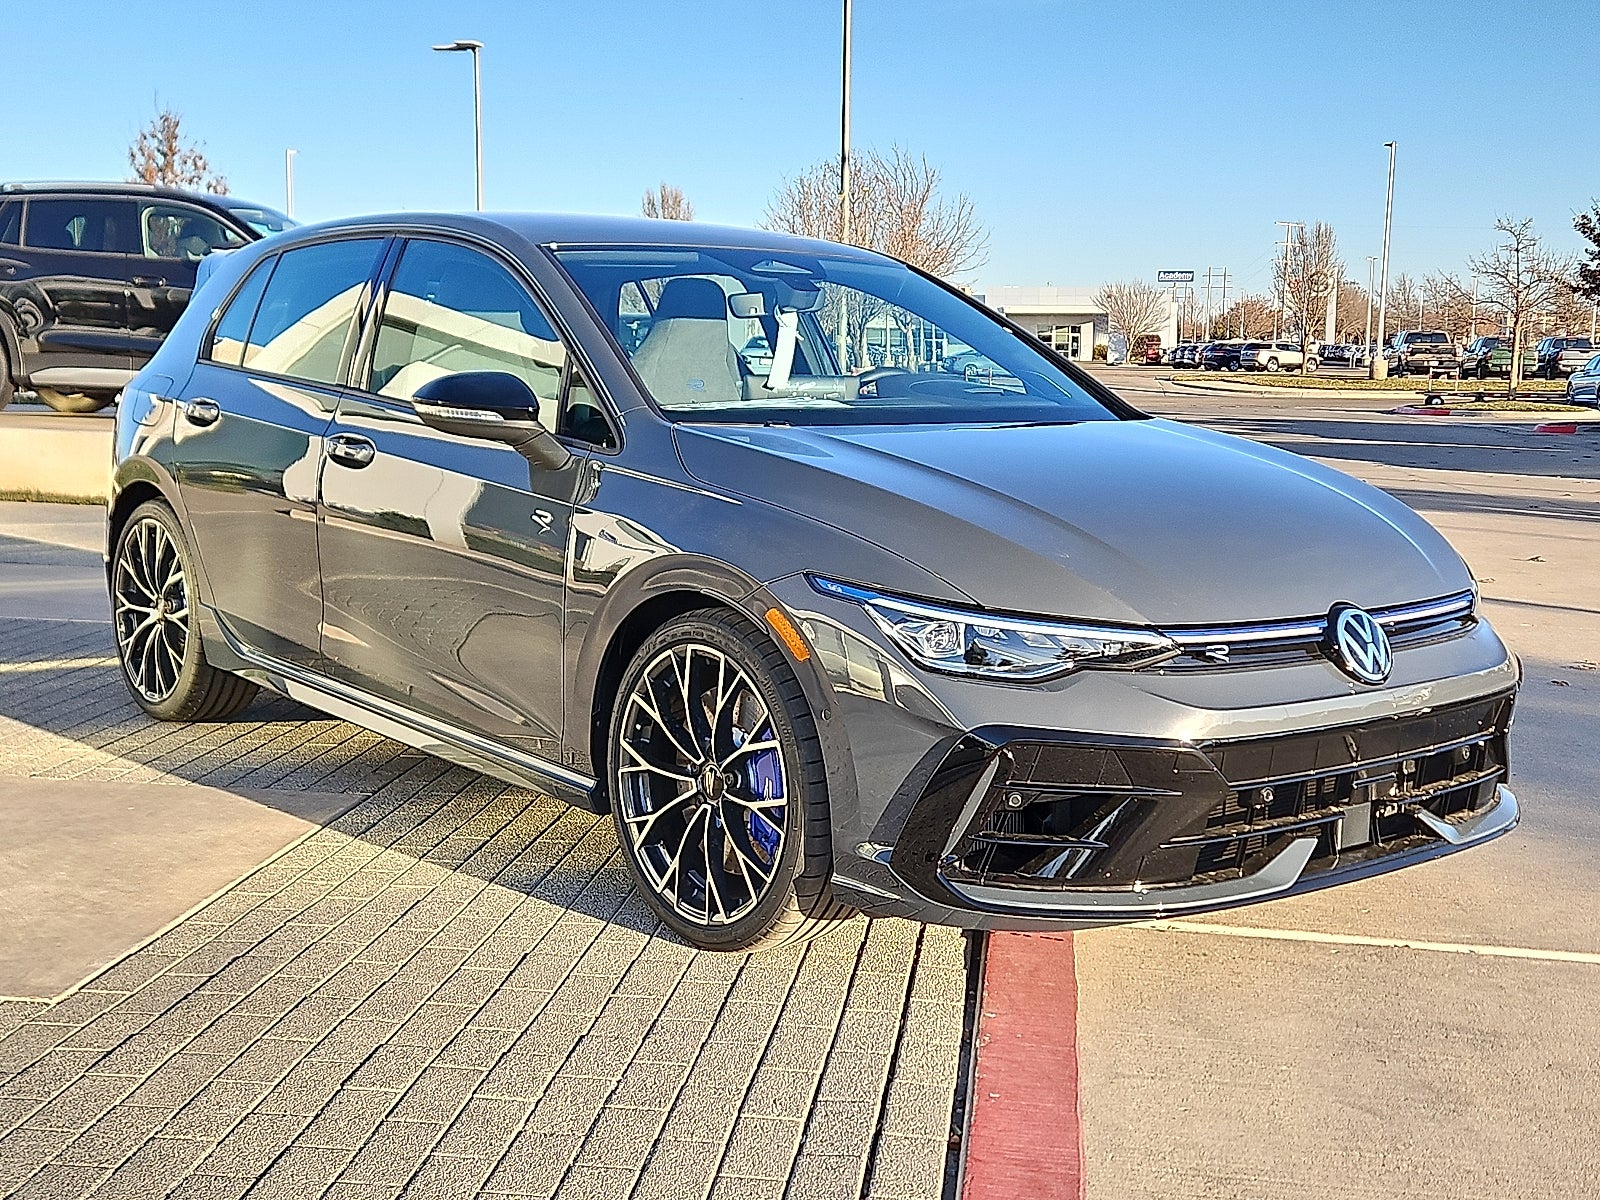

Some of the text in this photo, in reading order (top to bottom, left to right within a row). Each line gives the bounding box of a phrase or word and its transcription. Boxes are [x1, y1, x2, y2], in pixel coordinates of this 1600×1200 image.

[1159, 271, 1193, 280] Academy
[1206, 644, 1230, 663] R
[1337, 608, 1392, 681] VW
